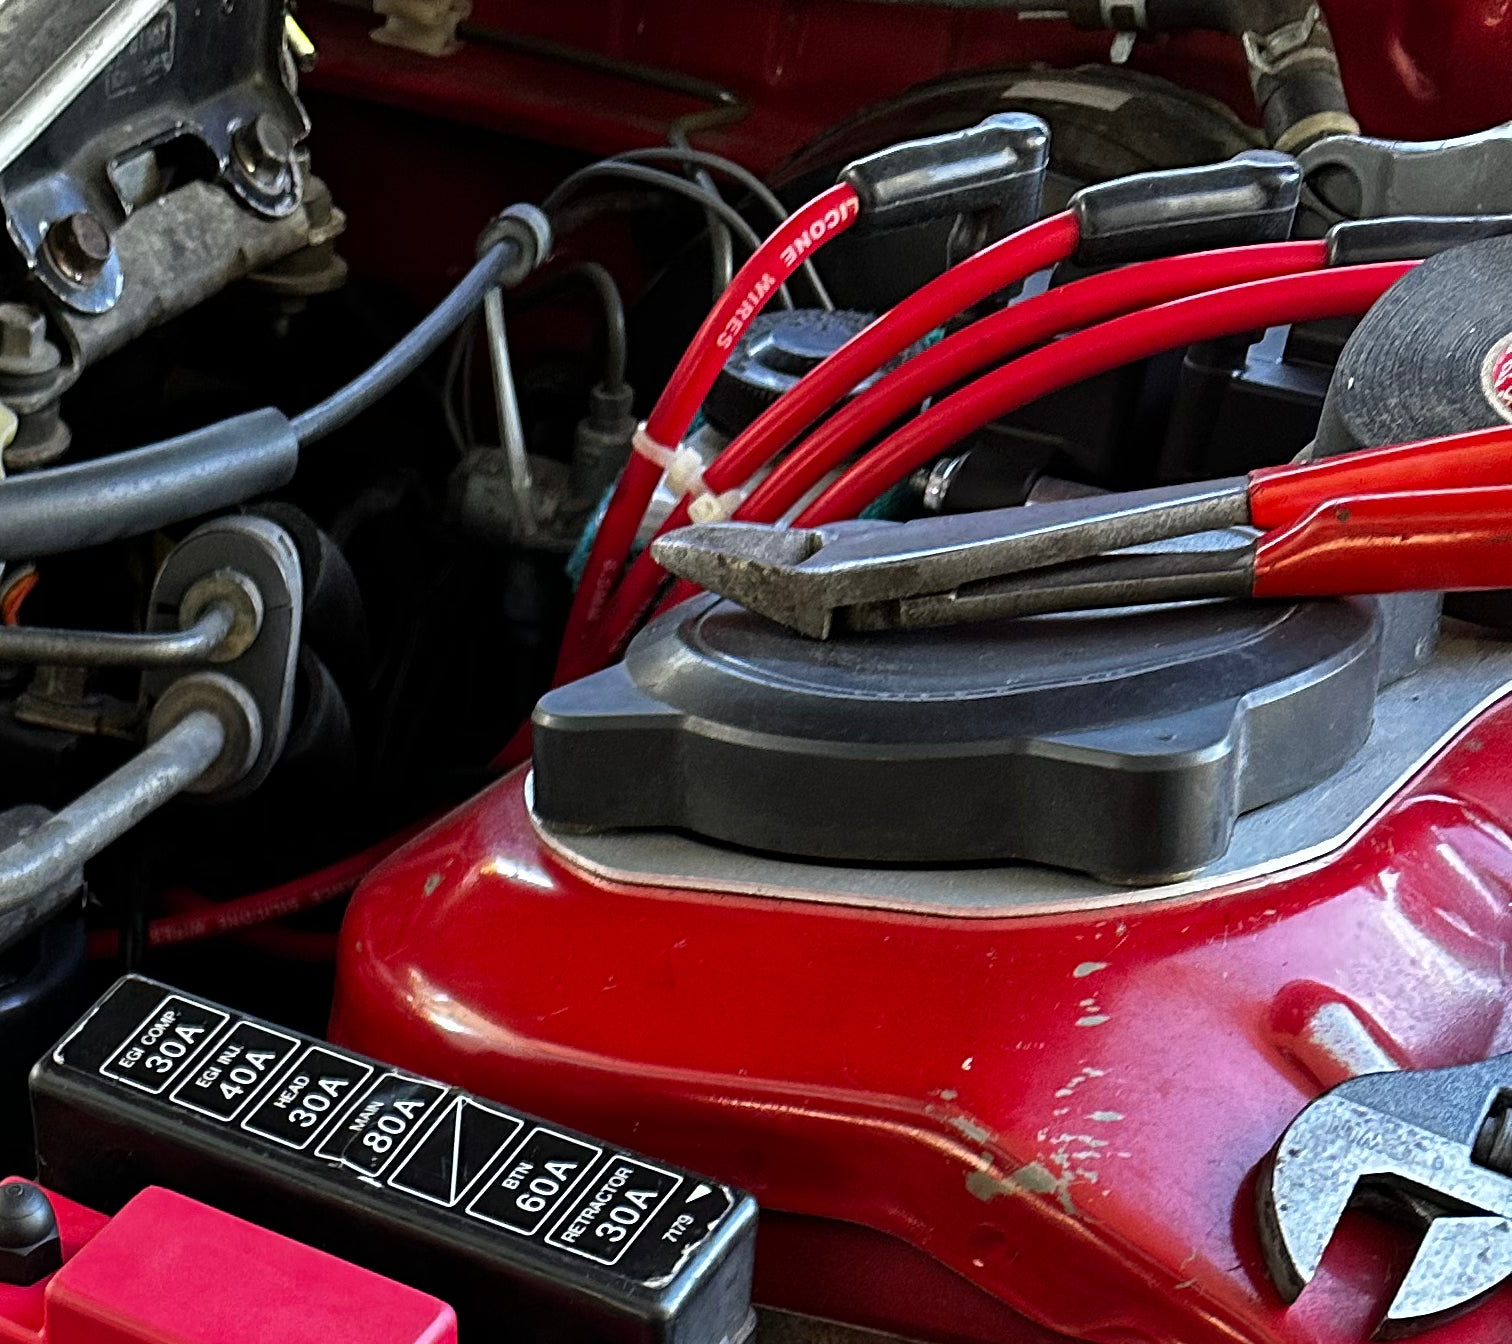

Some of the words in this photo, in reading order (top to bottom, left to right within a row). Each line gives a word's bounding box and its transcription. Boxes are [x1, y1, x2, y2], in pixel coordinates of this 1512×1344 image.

[717, 273, 776, 349] WIRES
[118, 1047, 145, 1068] EGI
[145, 1025, 205, 1073] 30A
[195, 1066, 223, 1088] EGI
[219, 1051, 276, 1100] 40A
[273, 1075, 310, 1109] HEAD
[289, 1079, 349, 1128] 30A
[348, 1101, 384, 1132] MAIN
[363, 1100, 425, 1153] 80A
[501, 1161, 535, 1190] BTN
[516, 1160, 579, 1212] 60A
[561, 1167, 634, 1243] RETRACTOR
[595, 1190, 659, 1242] 30A
